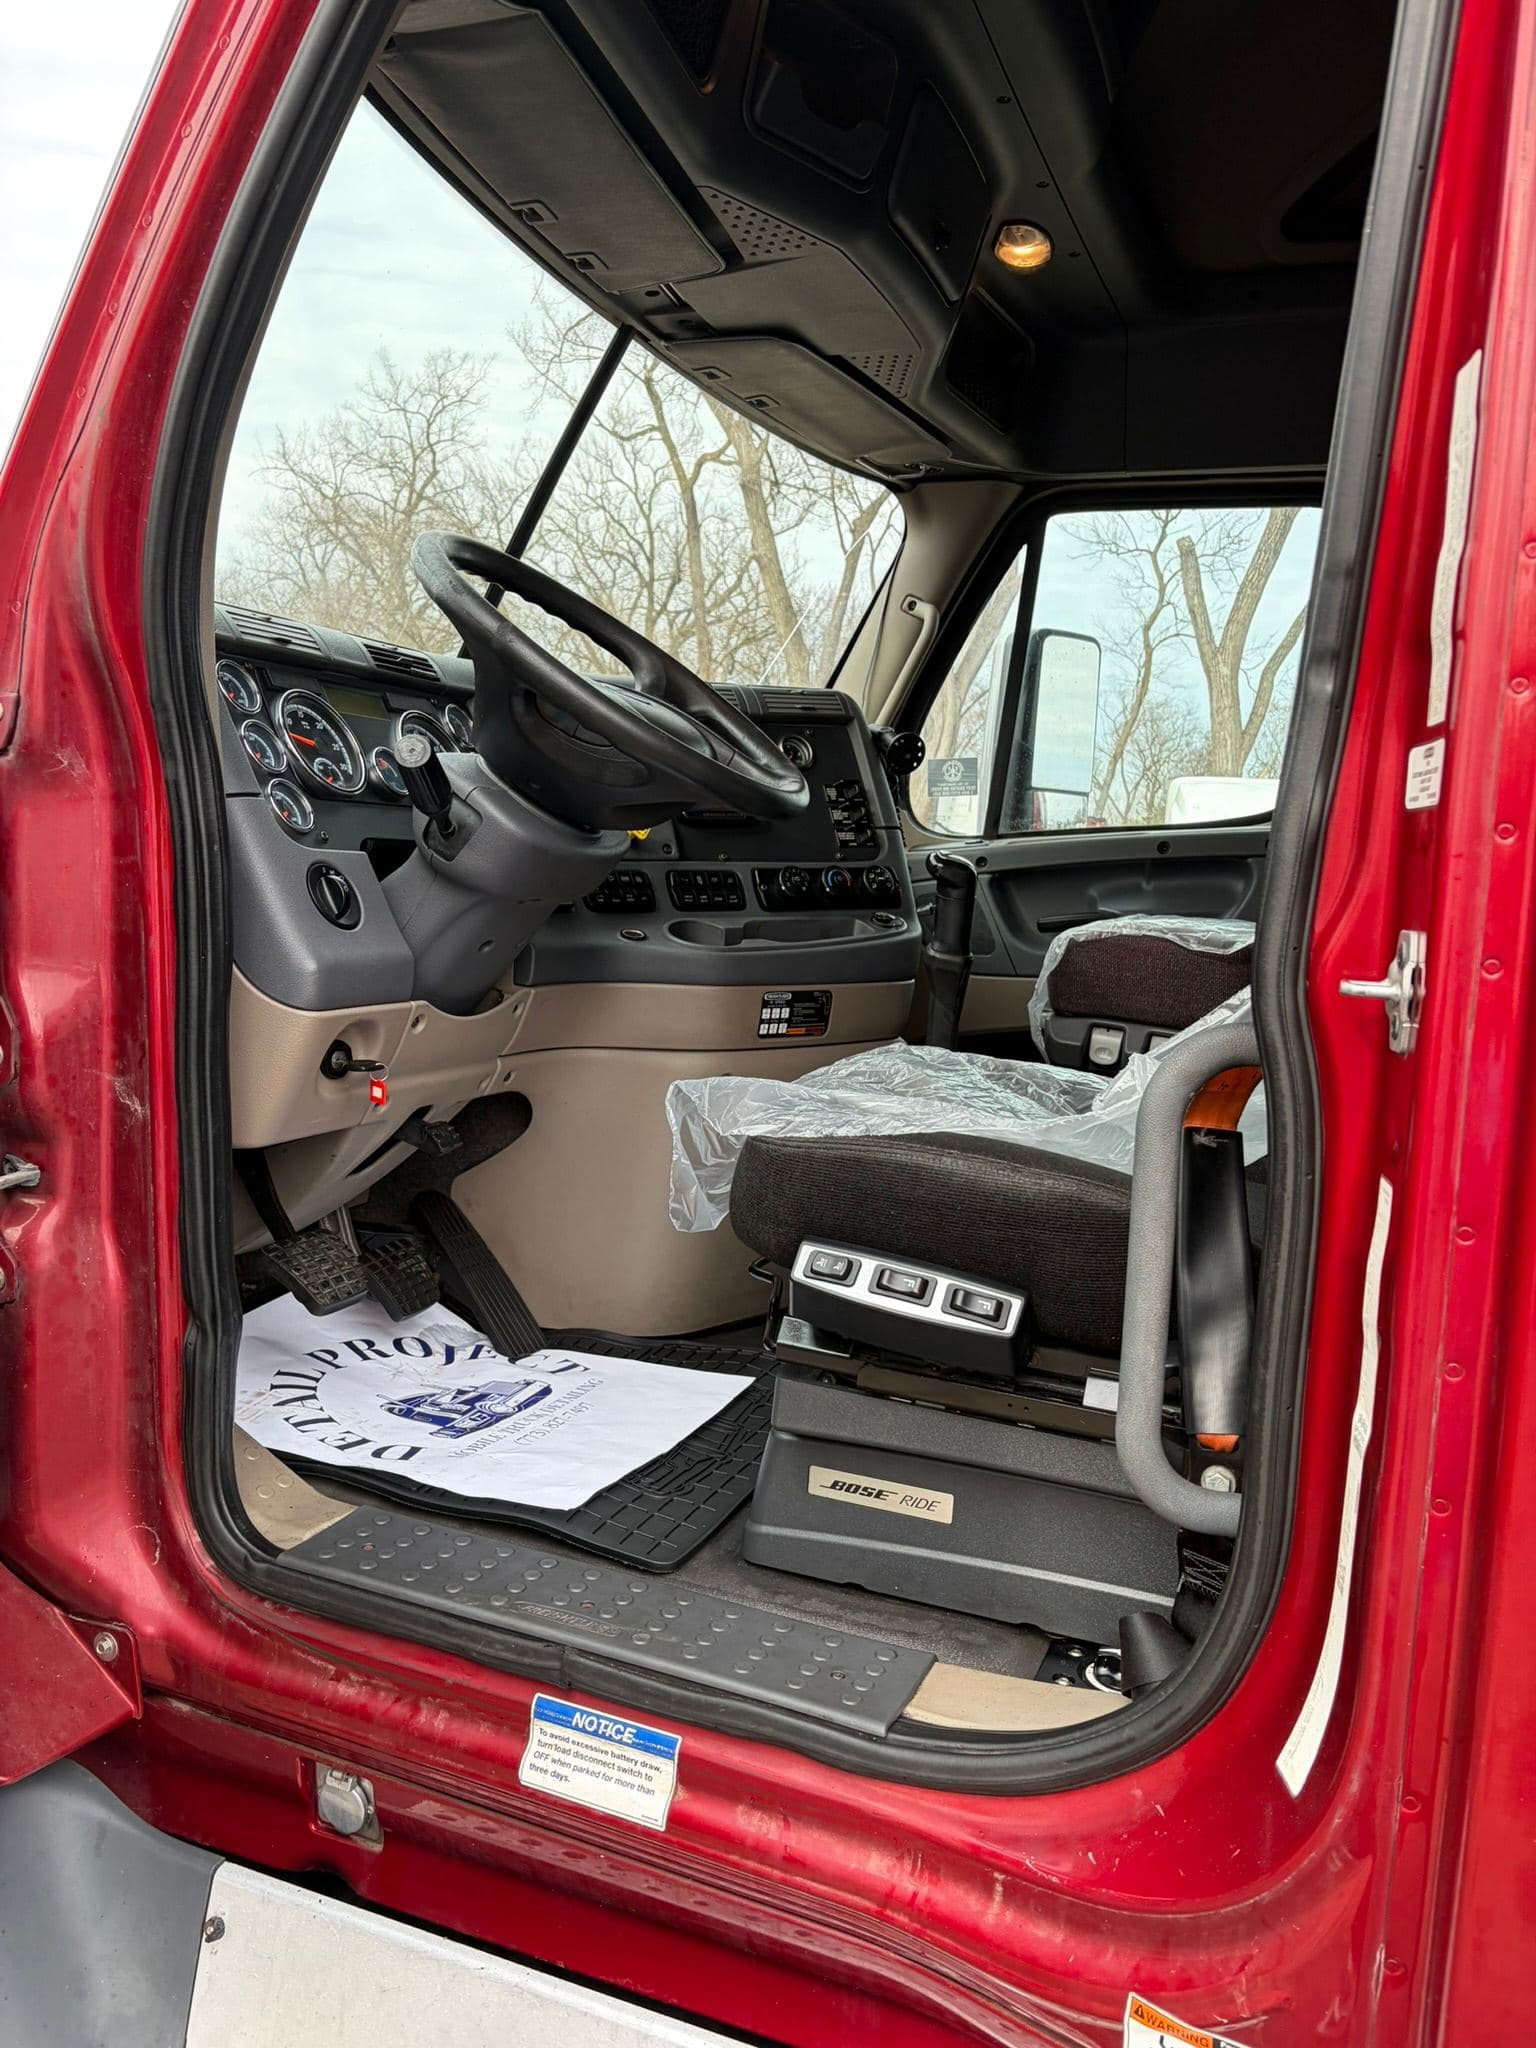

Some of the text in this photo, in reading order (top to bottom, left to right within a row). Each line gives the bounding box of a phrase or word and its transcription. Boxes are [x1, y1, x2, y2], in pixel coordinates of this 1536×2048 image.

[270, 1367, 427, 1461] DETAIL
[819, 1479, 941, 1512] BOSE RIDE
[571, 1711, 637, 1745] NOTICE
[537, 1739, 552, 1752] turn
[573, 1749, 615, 1771] disconnect
[616, 1763, 643, 1779] switch
[644, 1771, 653, 1782] to
[538, 1727, 663, 1774] To avoid excessive battery draw,
[528, 1762, 571, 1784] three days.
[533, 1750, 656, 1797] OFF when parked for more than
[1146, 2011, 1210, 2048] WARNING
